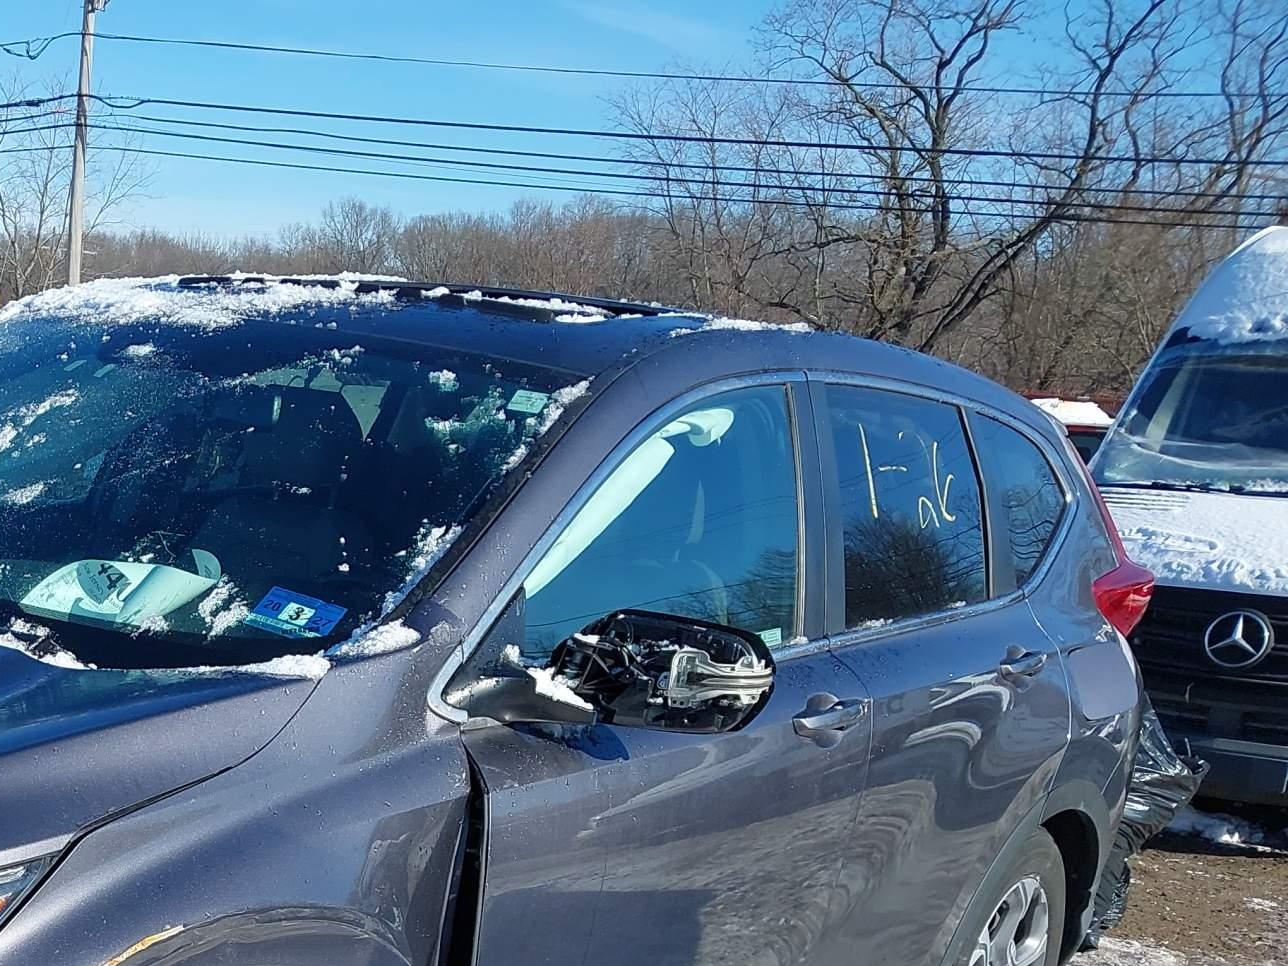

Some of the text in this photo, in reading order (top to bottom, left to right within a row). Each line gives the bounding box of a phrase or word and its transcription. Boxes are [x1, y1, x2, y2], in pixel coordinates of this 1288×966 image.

[263, 599, 282, 612] 20
[288, 606, 305, 621] 3
[312, 616, 335, 627] 27
